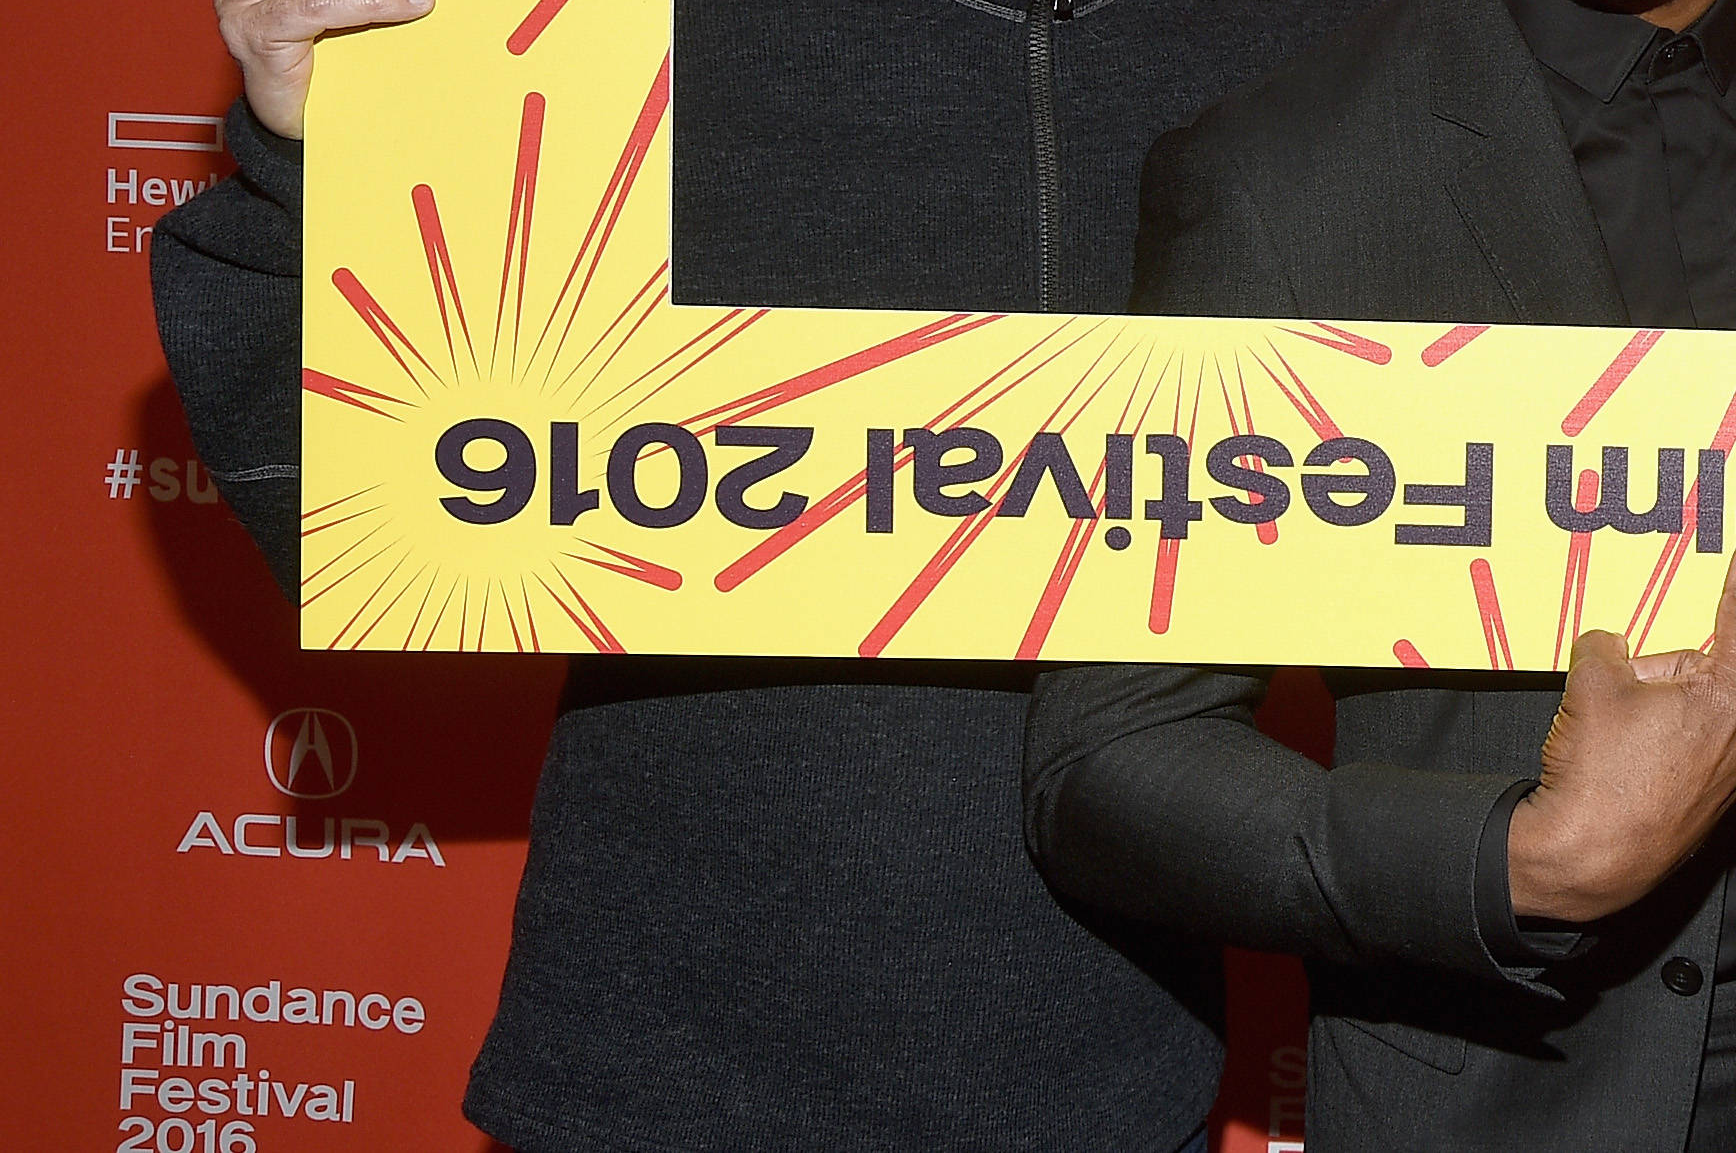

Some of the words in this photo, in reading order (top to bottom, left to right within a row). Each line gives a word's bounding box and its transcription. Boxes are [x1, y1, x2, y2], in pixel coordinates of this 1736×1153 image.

[434, 417, 815, 531] 2016
[865, 427, 1495, 552] Festival
[176, 811, 447, 867] ACURA
[121, 973, 426, 1035] Sundance
[121, 1020, 247, 1069] Film
[119, 1068, 355, 1123] Festival
[115, 1116, 257, 1153] 2016
